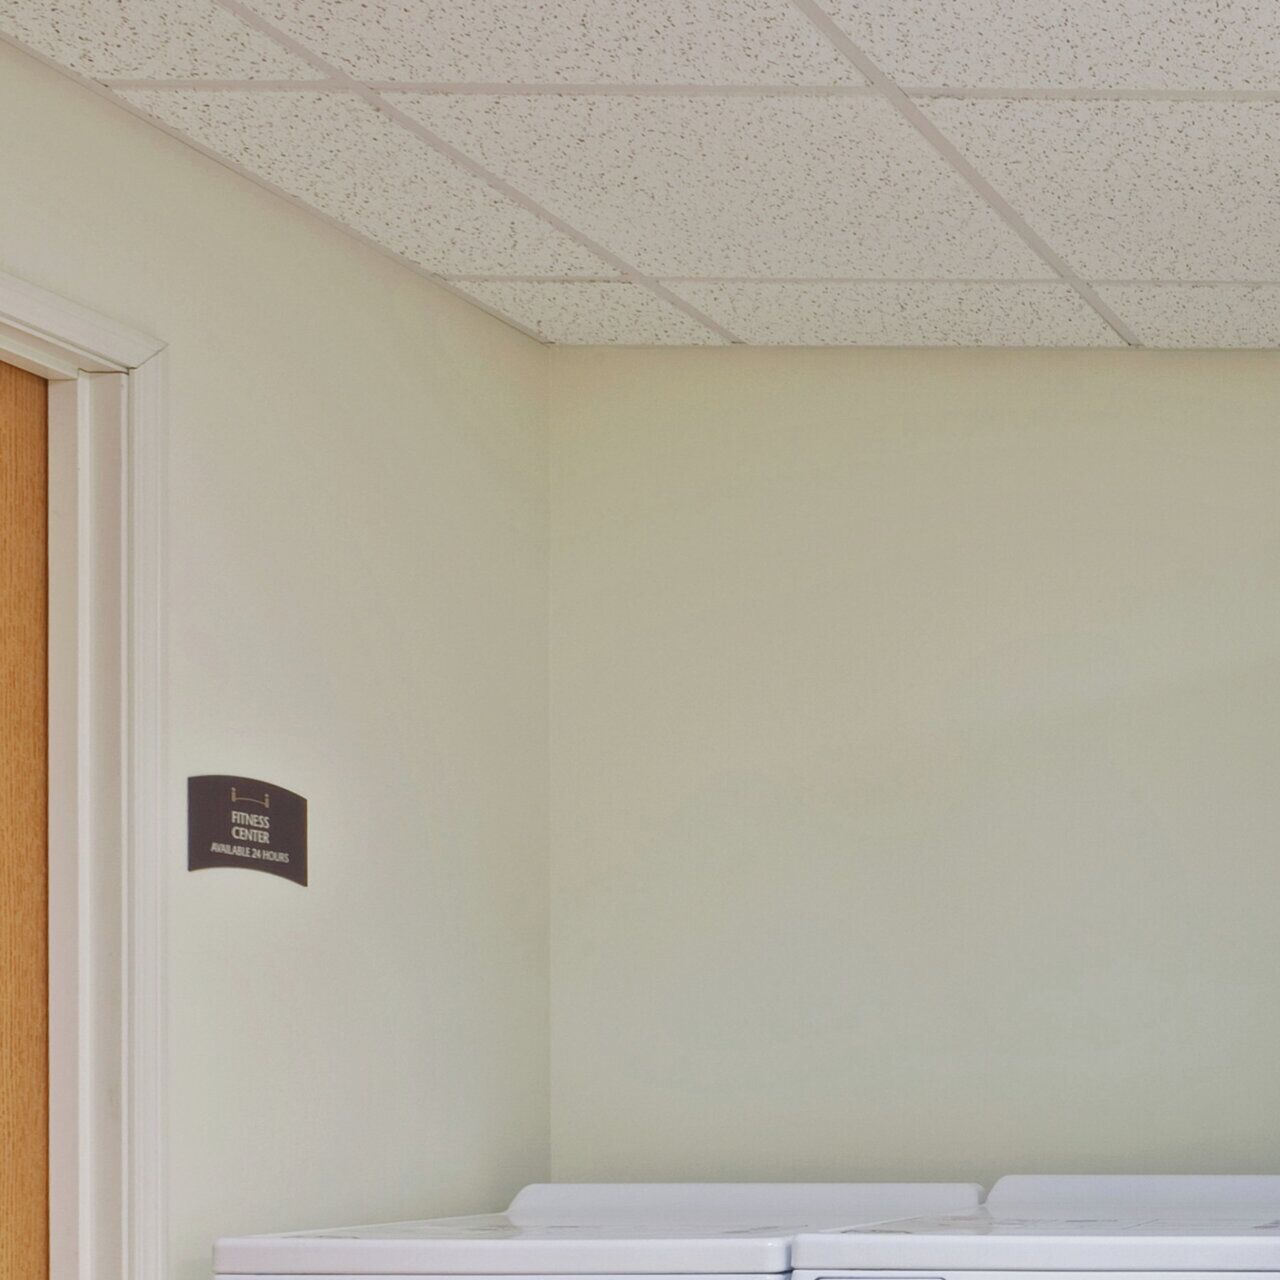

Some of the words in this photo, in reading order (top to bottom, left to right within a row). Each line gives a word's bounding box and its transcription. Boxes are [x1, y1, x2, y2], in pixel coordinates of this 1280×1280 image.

[231, 811, 270, 828] FITNESS
[231, 826, 270, 843] CENTER
[211, 842, 250, 857] AVAILABLE
[251, 848, 261, 859] 24
[262, 850, 290, 863] HOURS
